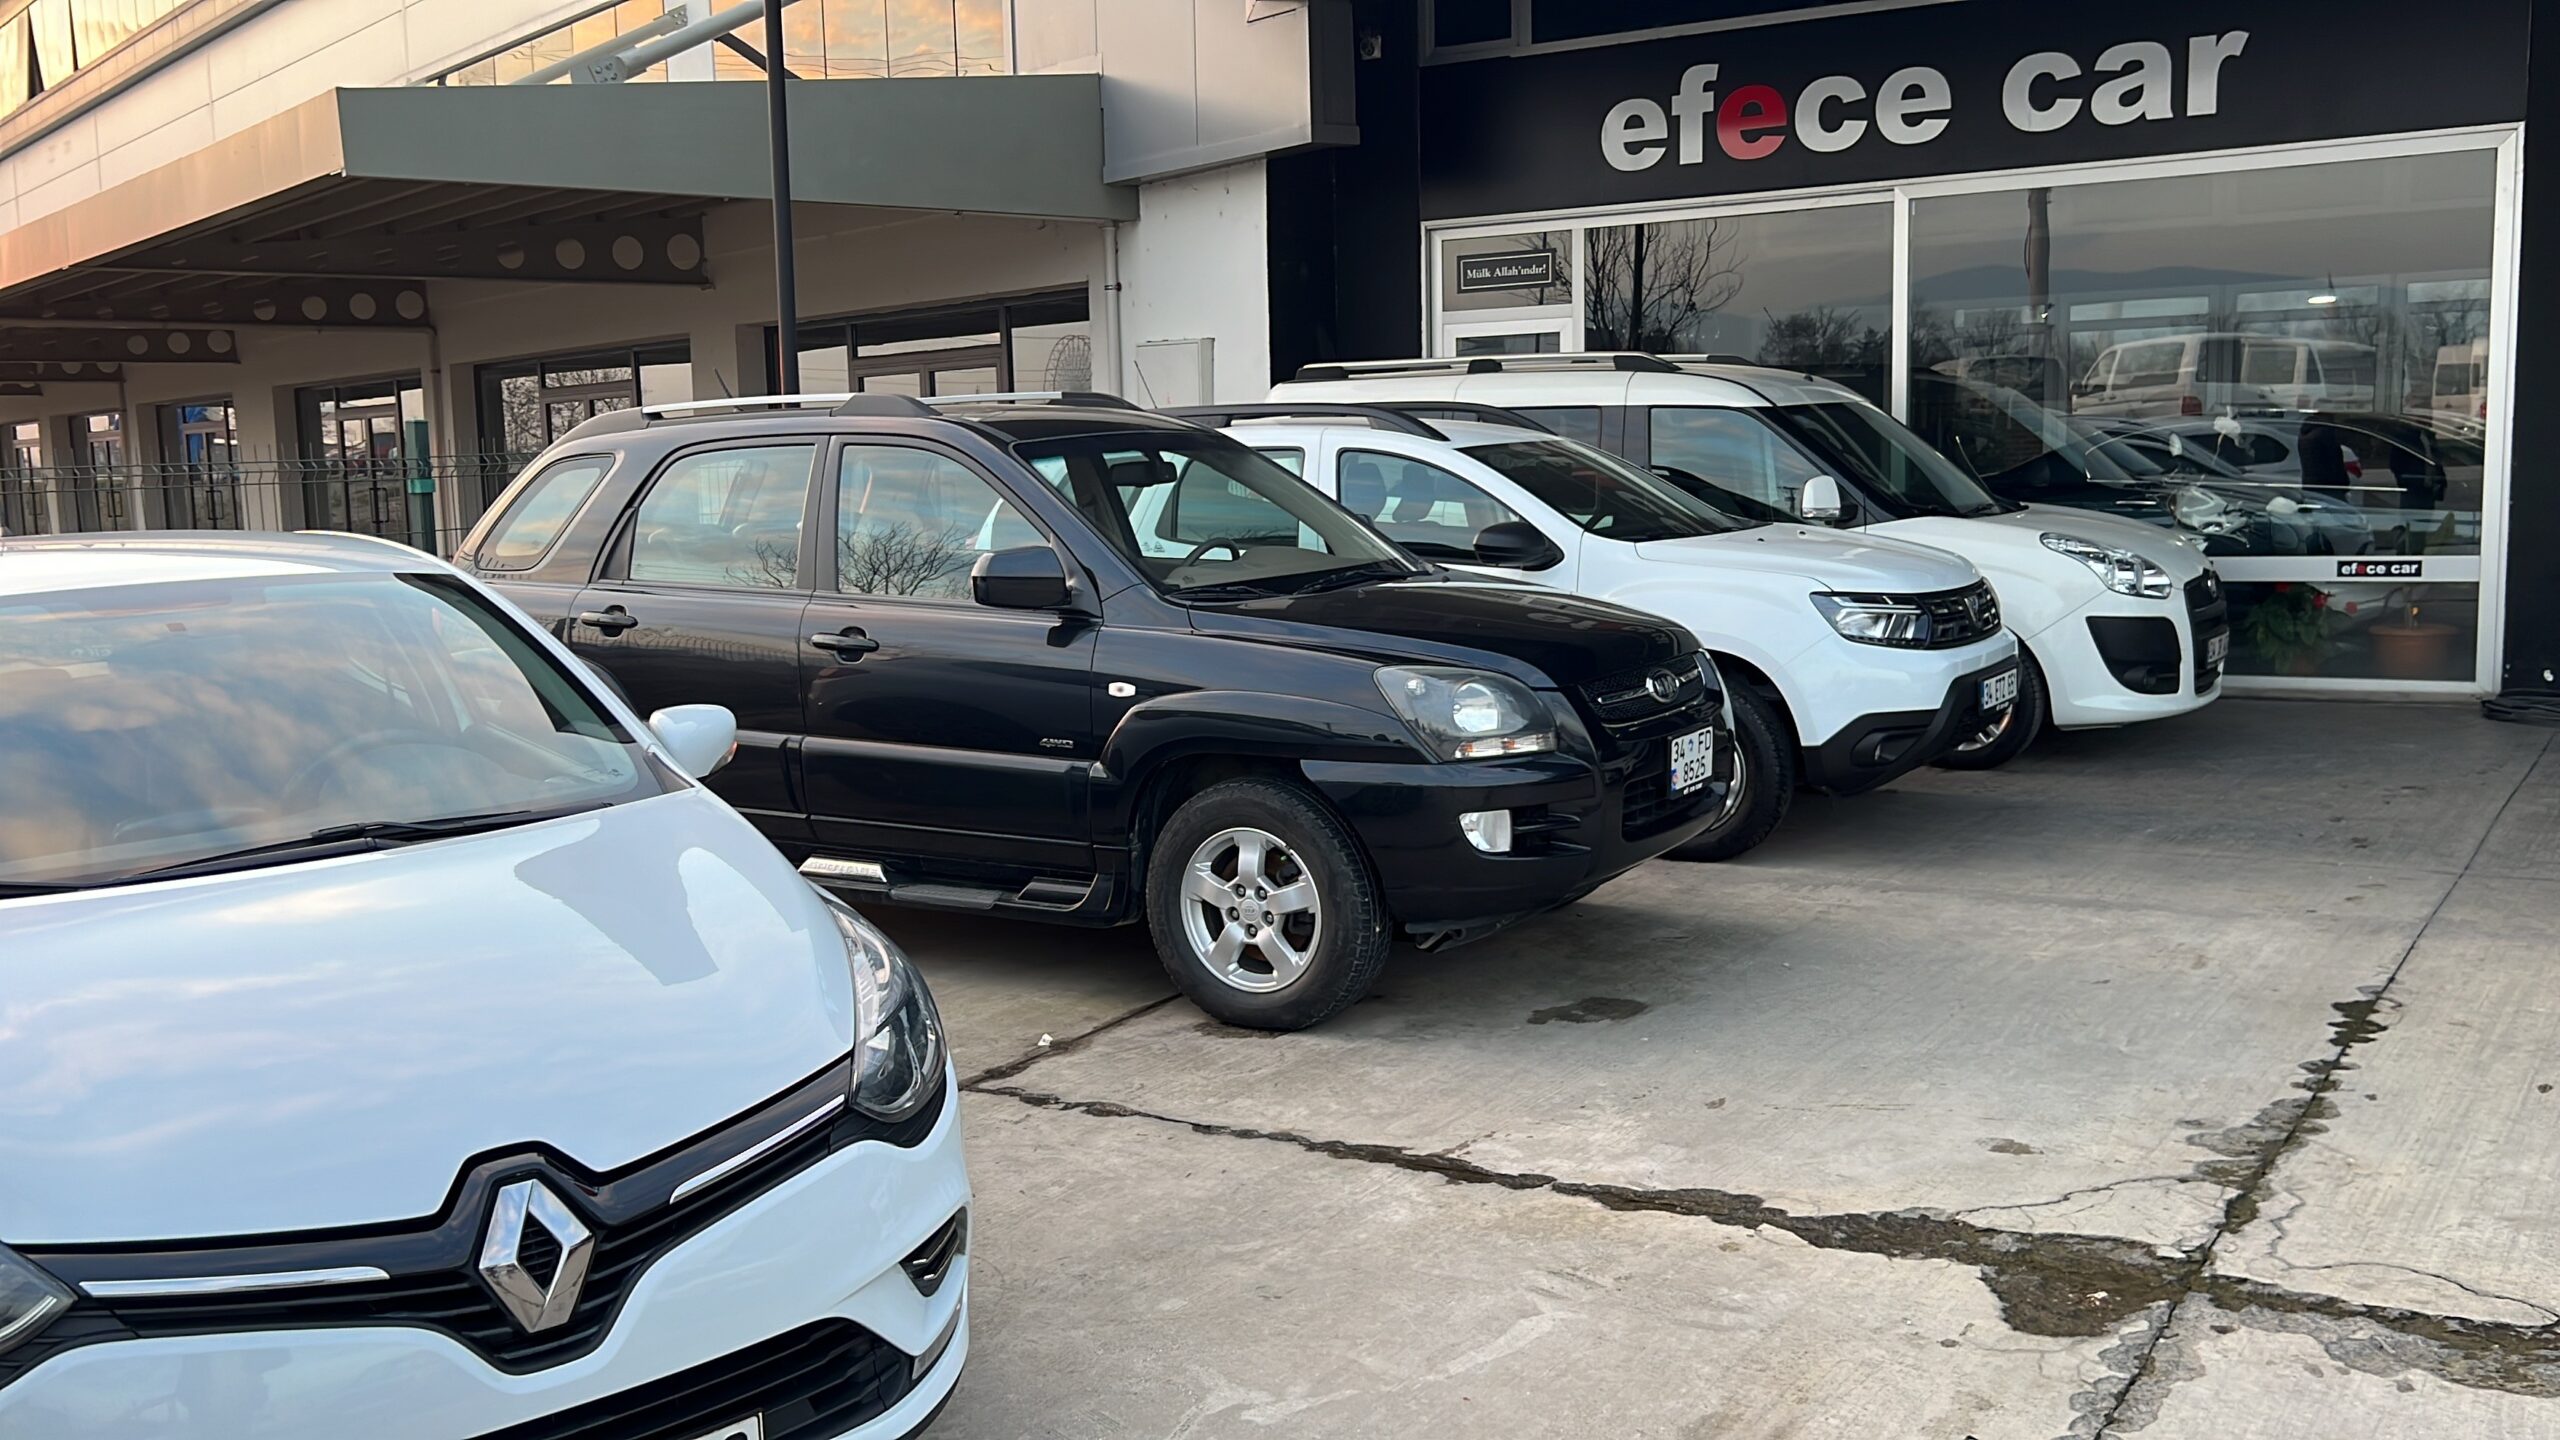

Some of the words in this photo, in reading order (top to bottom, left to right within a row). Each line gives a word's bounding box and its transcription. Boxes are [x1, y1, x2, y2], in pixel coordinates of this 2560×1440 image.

[1601, 63, 1952, 172] efece
[2001, 30, 2250, 133] car
[1466, 268, 1491, 279] Mülk
[2341, 562, 2387, 575] efece
[2390, 564, 2419, 575] car
[1985, 682, 1993, 707] 34
[1673, 739, 1686, 763] 34
[1698, 729, 1712, 754] FD
[1683, 755, 1707, 783] 8525
